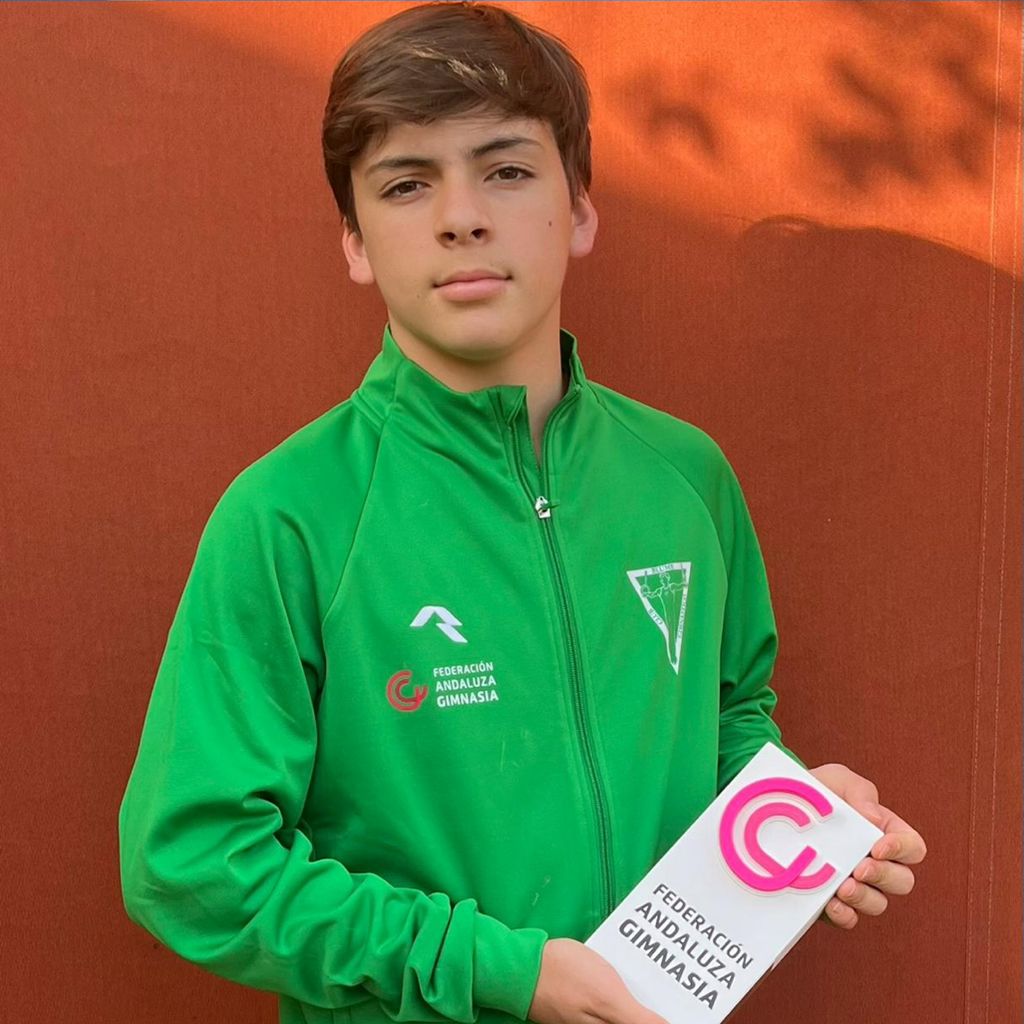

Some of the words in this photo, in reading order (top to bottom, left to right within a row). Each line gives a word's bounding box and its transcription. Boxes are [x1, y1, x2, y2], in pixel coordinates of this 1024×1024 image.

[433, 660, 494, 678] FEDERACIÓN
[435, 675, 497, 693] ANDALUZA
[437, 689, 499, 708] GIMNASIA
[635, 901, 736, 990] ANDALUZA
[652, 883, 754, 969] FEDERACIÓN
[618, 918, 719, 1010] GIMNASIA
